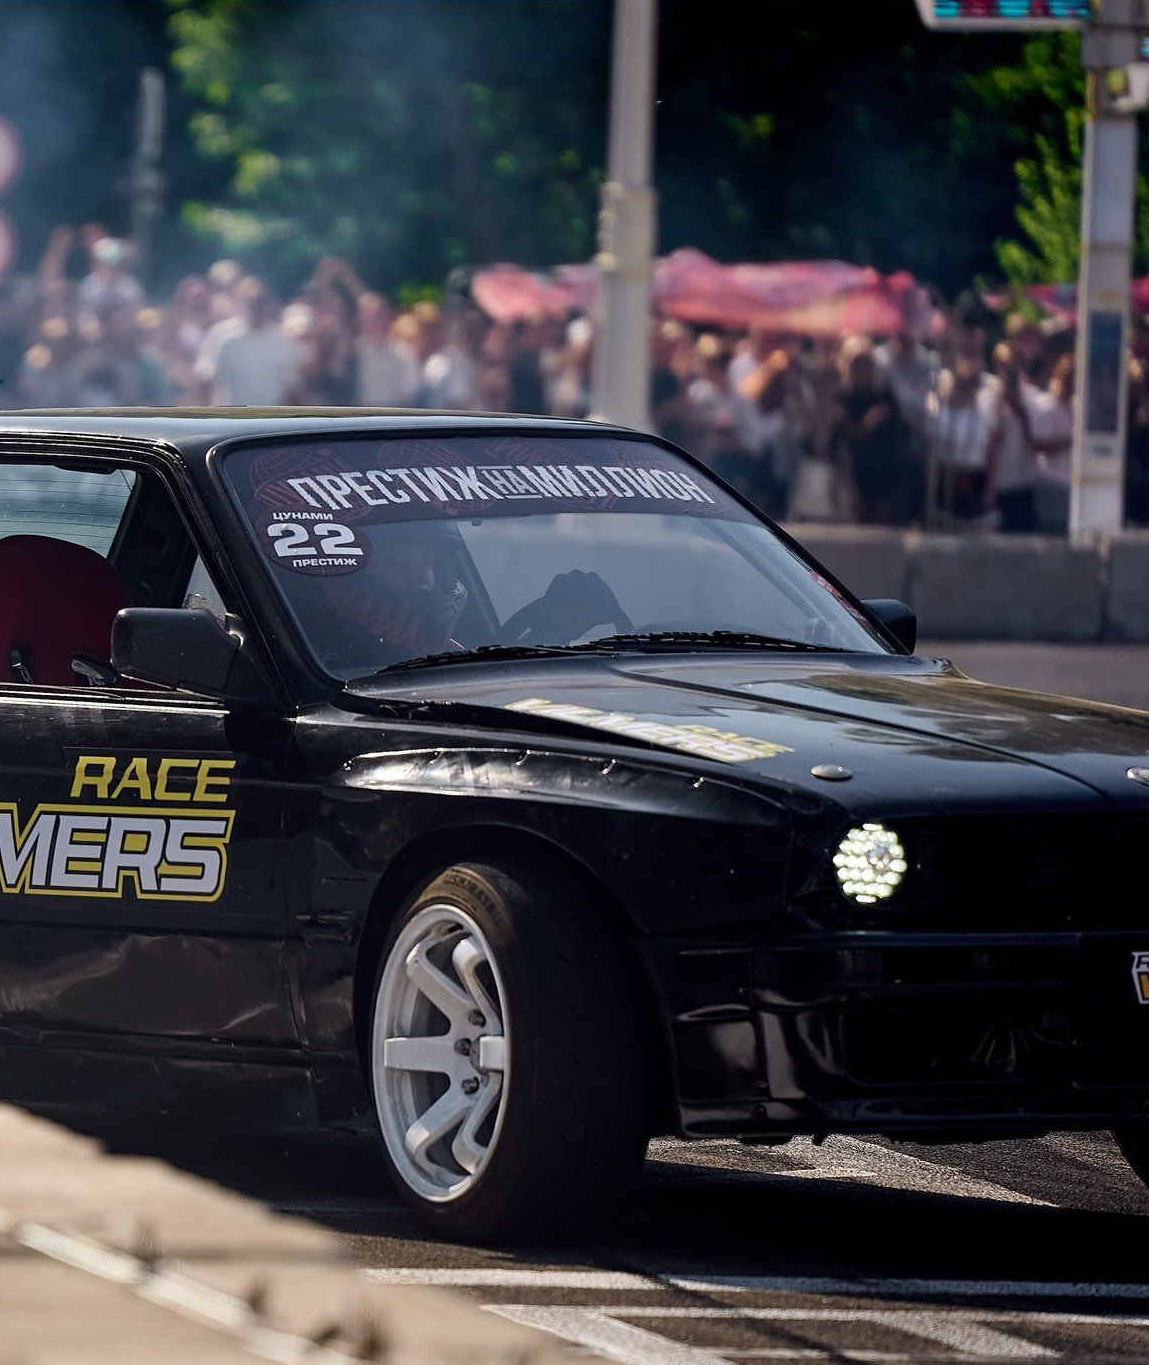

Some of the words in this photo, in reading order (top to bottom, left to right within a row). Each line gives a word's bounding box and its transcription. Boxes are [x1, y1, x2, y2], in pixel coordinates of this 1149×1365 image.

[287, 465, 501, 511] ПРЕСТИЖ
[272, 511, 334, 522] ЦУНАМИ
[267, 522, 365, 558] 22
[292, 557, 358, 569] ПРЕСТИЖ
[70, 755, 237, 803] RACE
